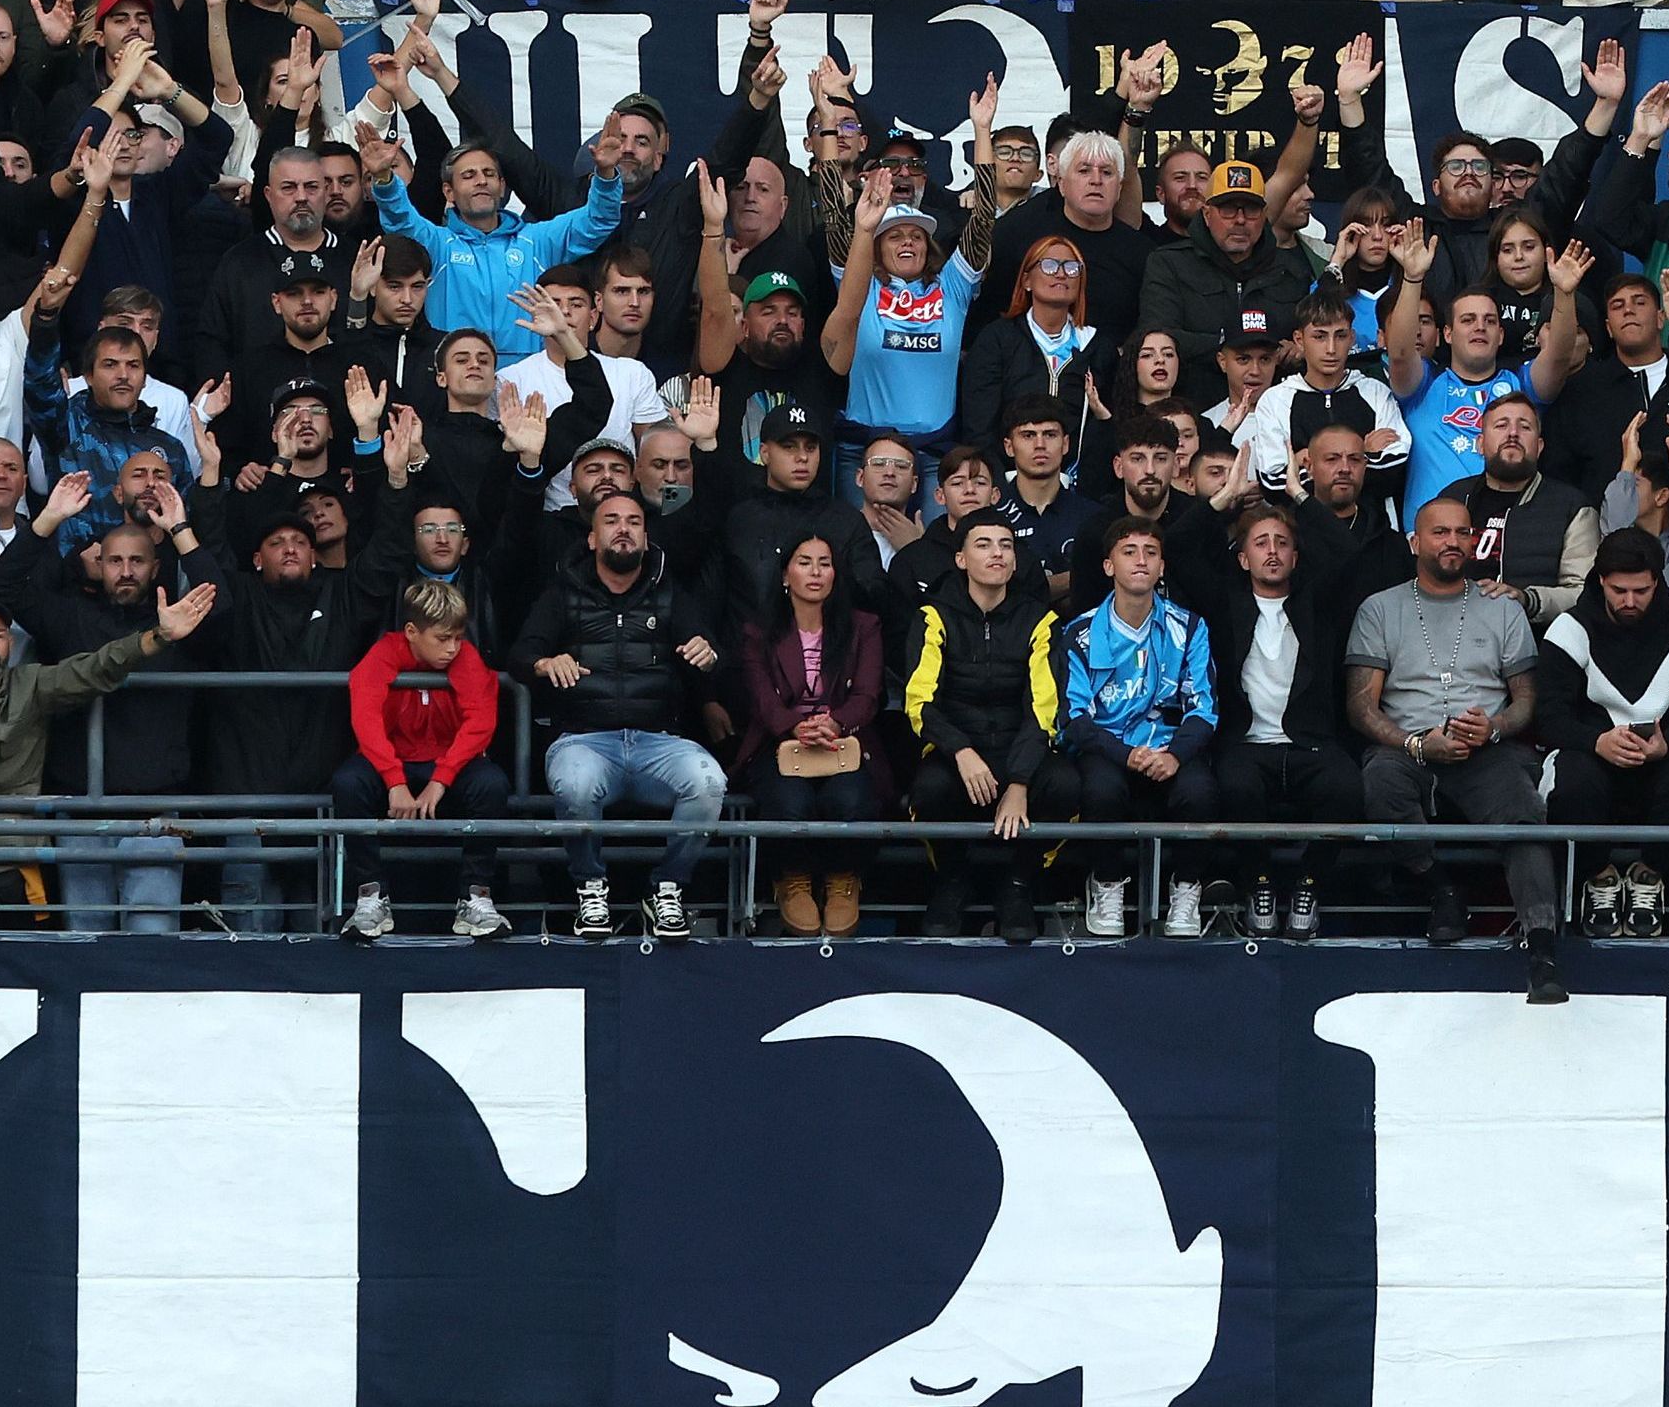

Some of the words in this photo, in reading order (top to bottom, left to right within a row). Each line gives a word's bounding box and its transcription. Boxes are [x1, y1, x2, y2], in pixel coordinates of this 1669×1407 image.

[451, 252, 475, 264] EA7
[771, 272, 789, 286] NY
[879, 288, 944, 322] Lete
[1242, 313, 1267, 322] RUN
[1242, 322, 1268, 331] DMC
[903, 335, 941, 349] MSC
[789, 407, 806, 423] NY
